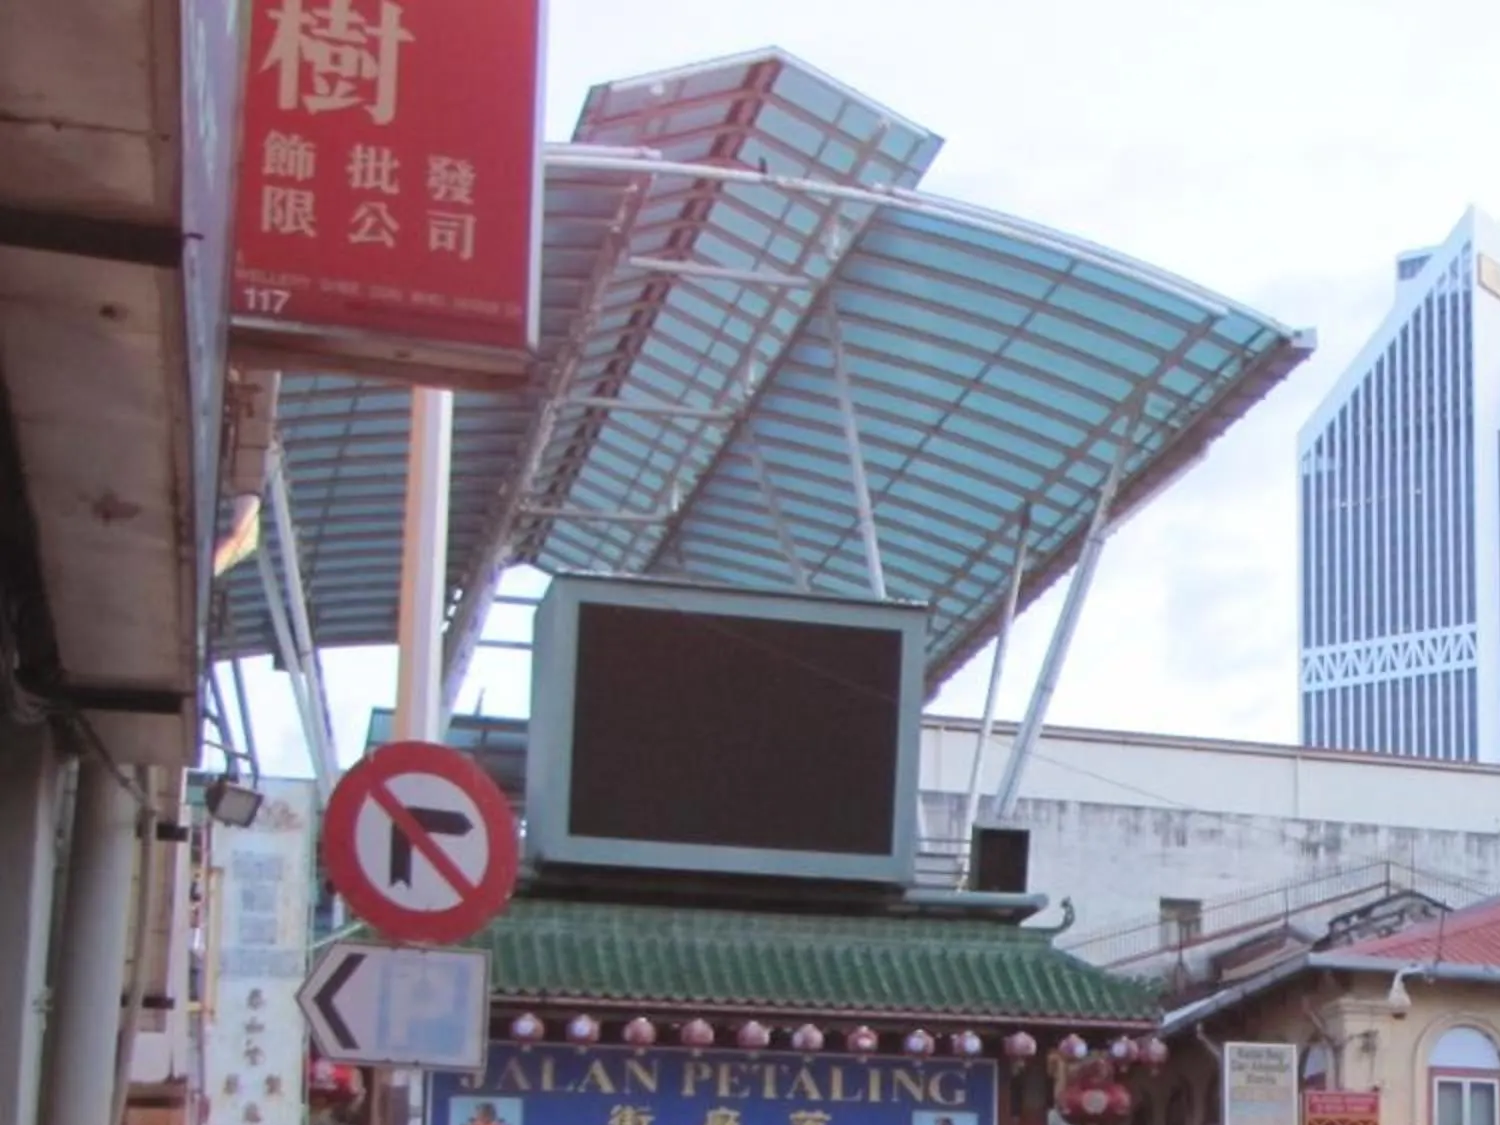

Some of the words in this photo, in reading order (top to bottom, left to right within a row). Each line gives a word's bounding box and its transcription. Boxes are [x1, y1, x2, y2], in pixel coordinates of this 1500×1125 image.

[244, 287, 291, 315] 117
[459, 1057, 660, 1095] JALAN
[680, 1060, 967, 1106] PETALING
